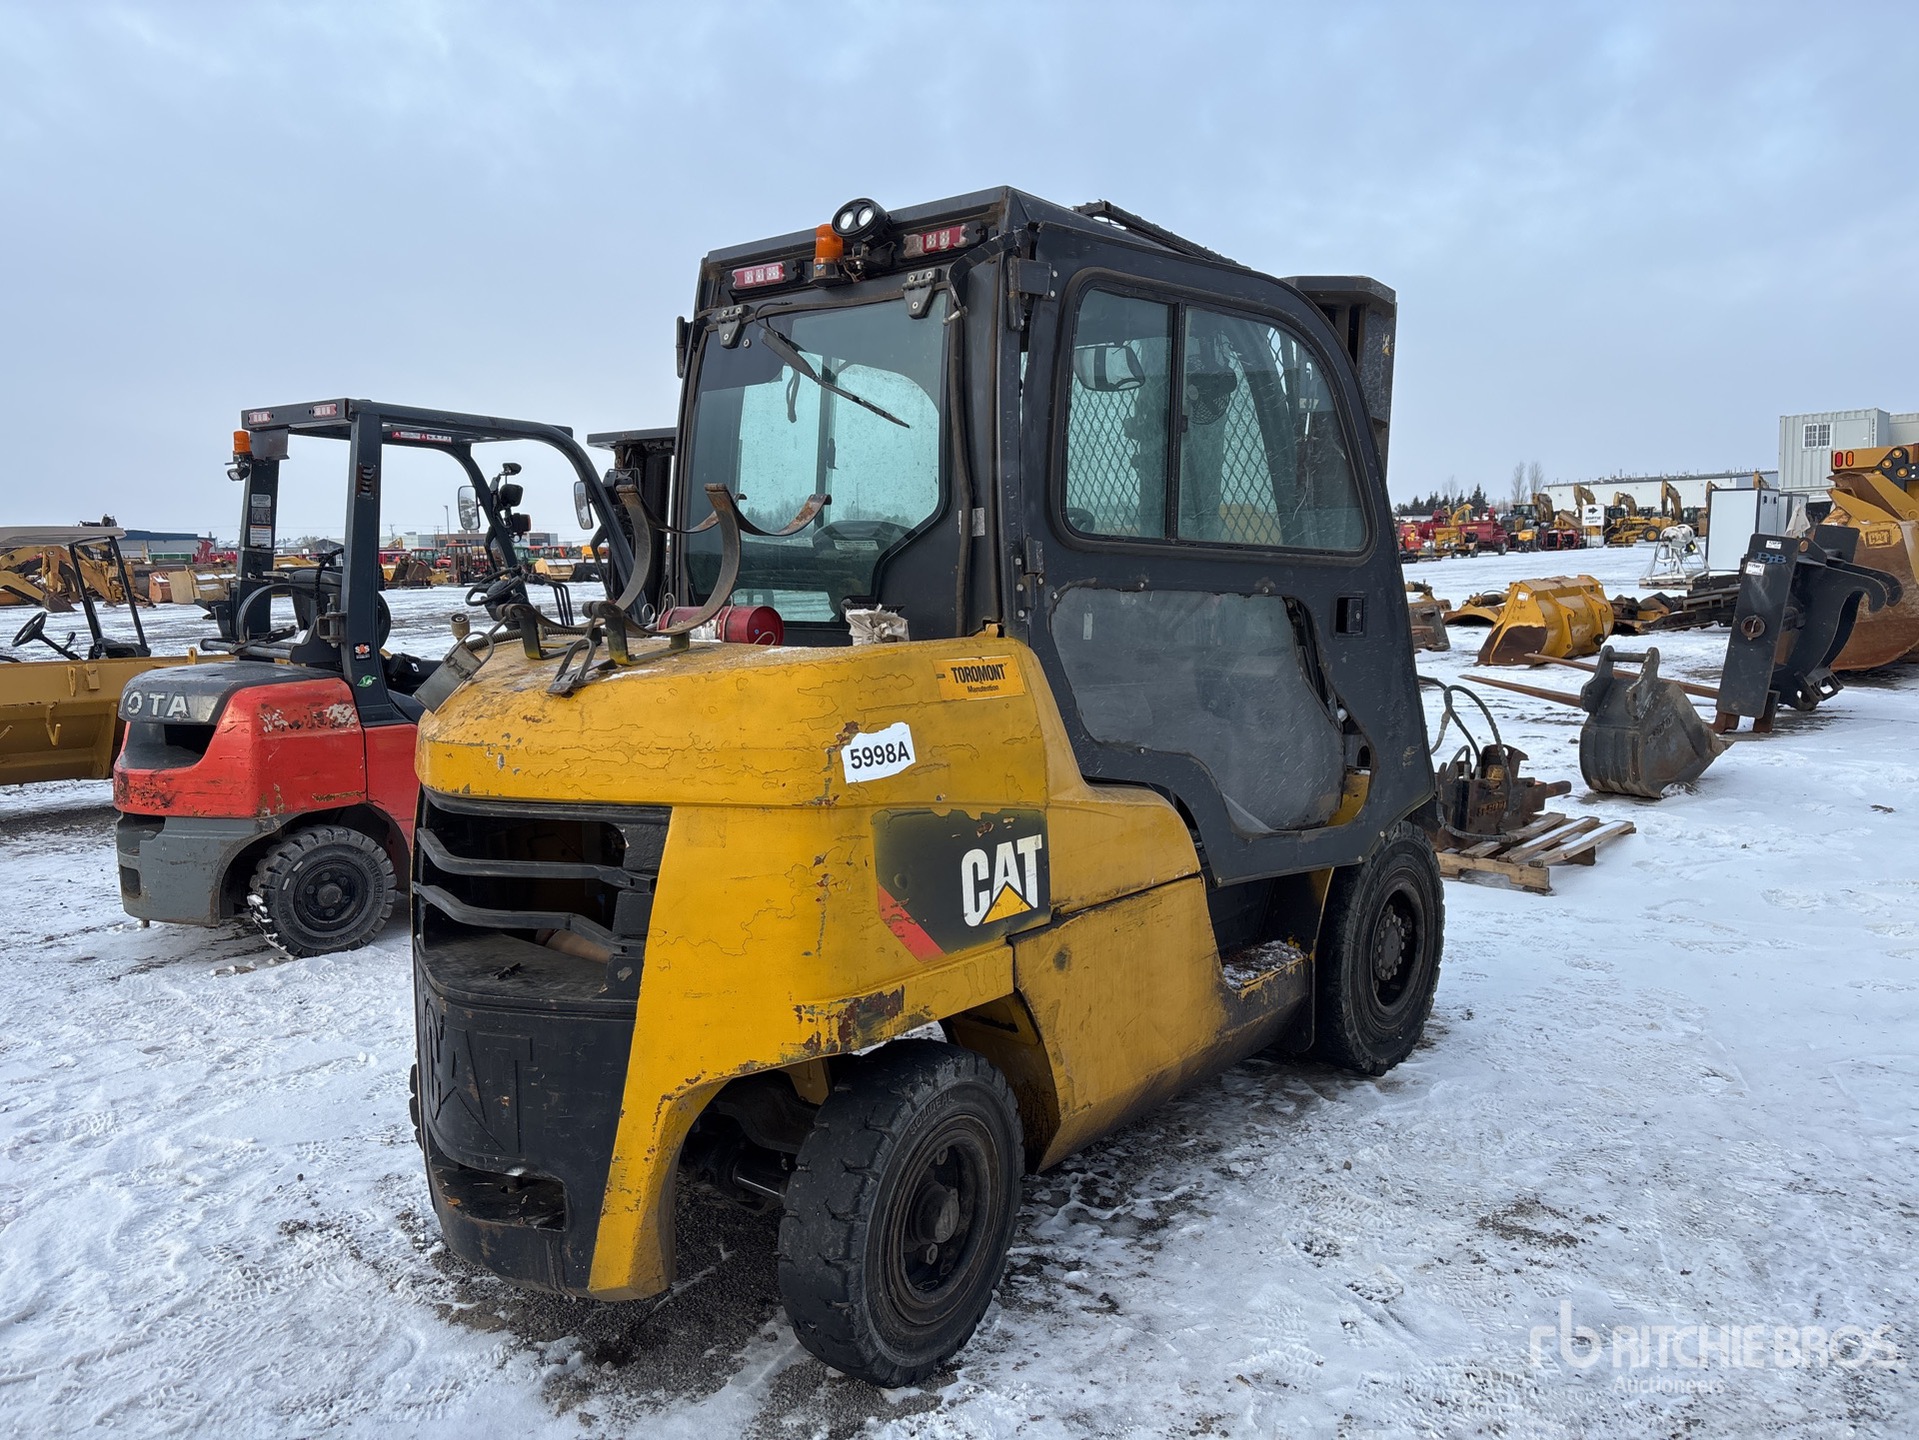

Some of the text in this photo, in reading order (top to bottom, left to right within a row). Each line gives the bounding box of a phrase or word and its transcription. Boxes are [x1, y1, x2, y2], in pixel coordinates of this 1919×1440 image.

[950, 663, 1006, 684] TOROMONT
[967, 685, 999, 693] Manutention
[850, 741, 910, 769] 5998A
[960, 834, 1043, 927] CAT
[909, 1091, 955, 1135] SOLIDEAL
